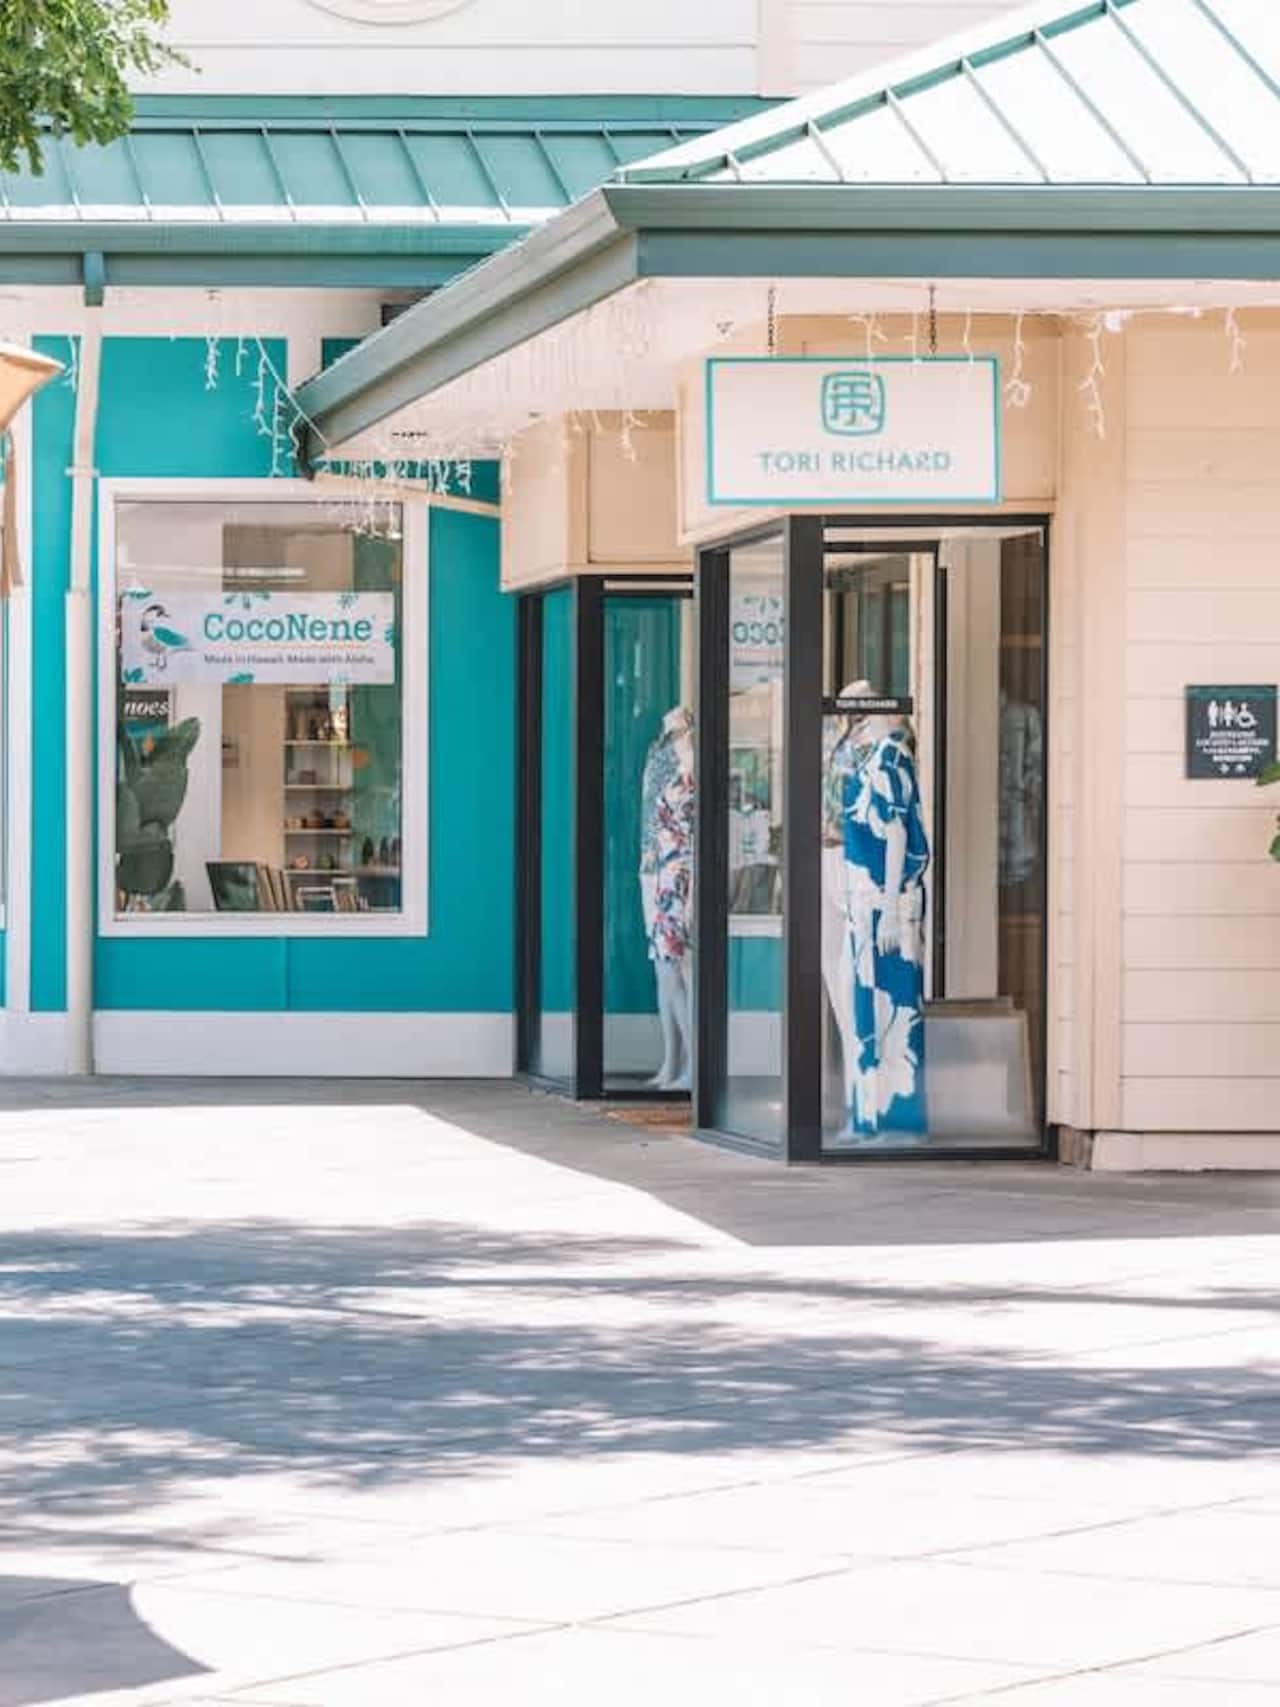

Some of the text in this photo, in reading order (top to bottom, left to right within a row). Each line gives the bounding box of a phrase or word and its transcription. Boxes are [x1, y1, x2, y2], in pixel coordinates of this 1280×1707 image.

[760, 452, 951, 473] TORI RICHARD
[203, 613, 372, 642] CocoNene
